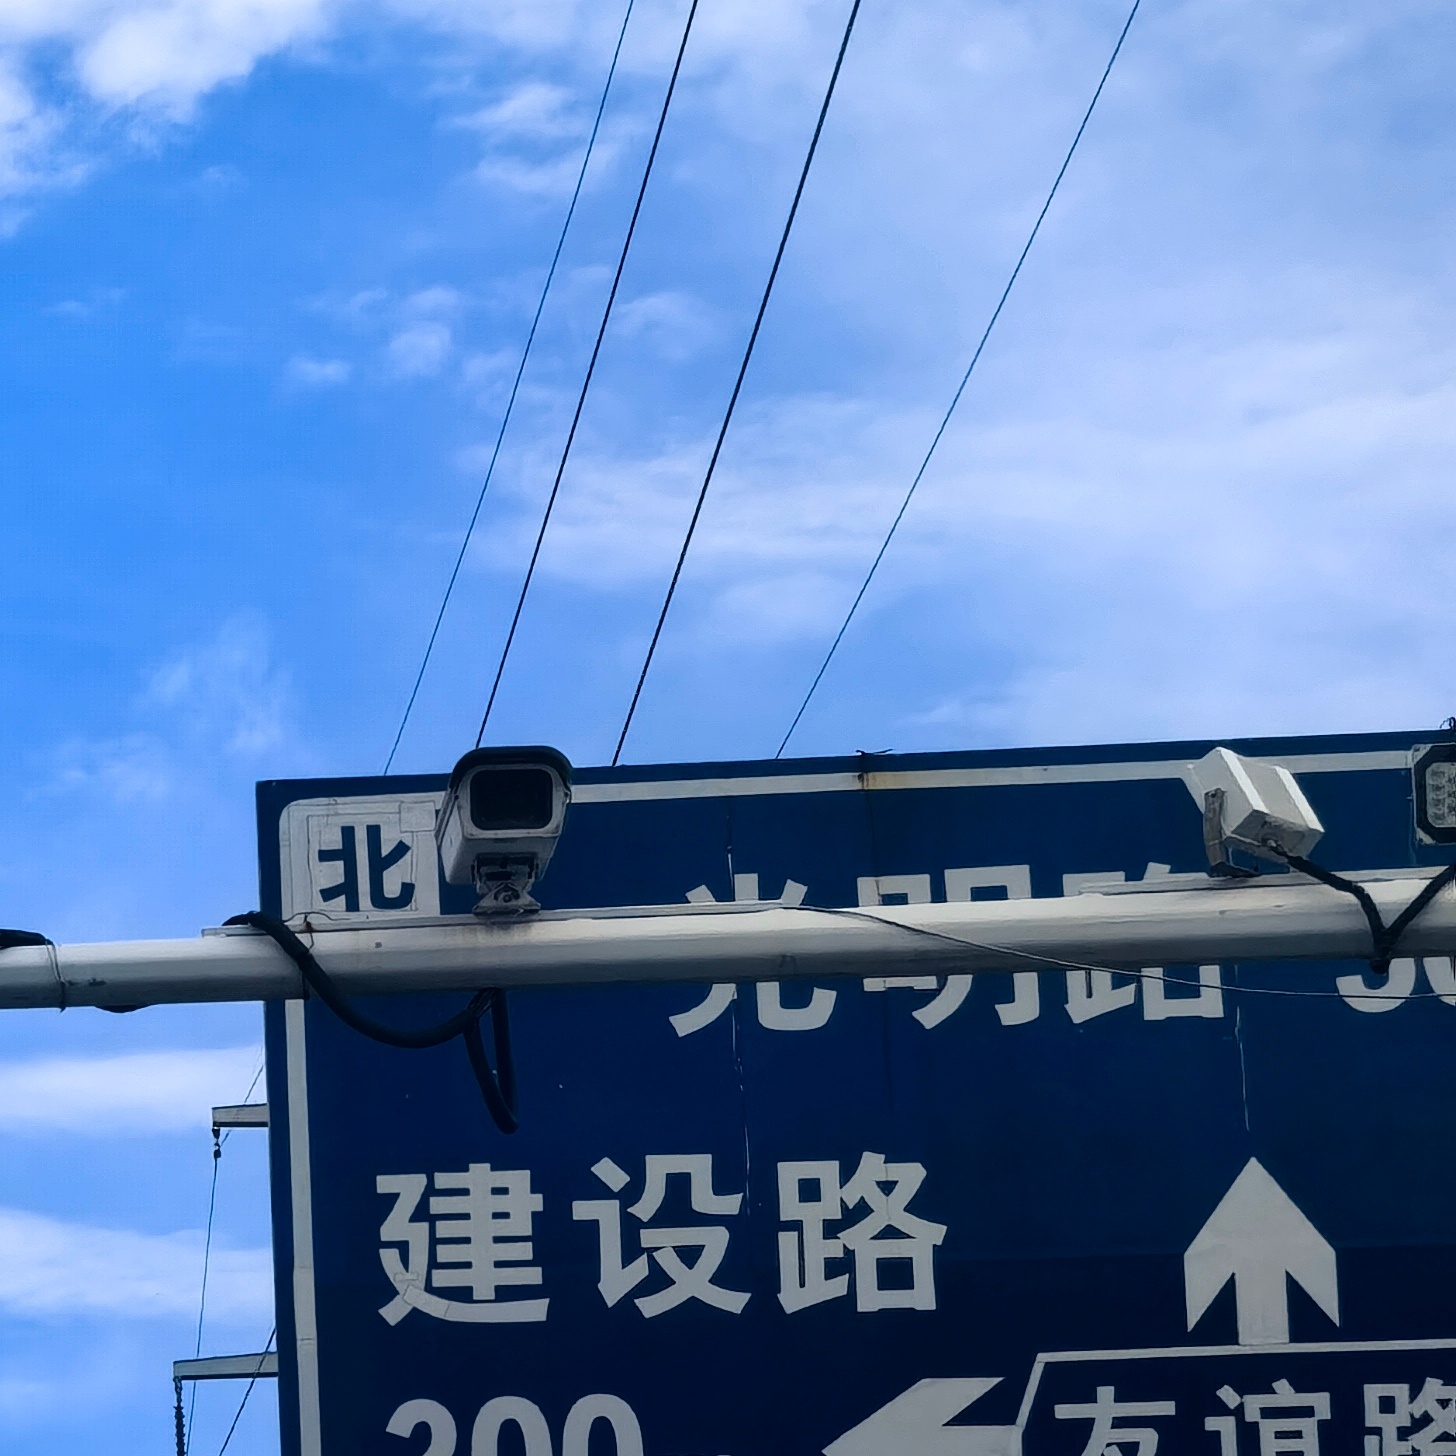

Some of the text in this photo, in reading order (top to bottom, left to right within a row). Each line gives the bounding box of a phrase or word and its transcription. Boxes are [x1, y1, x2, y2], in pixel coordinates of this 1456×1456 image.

[316, 824, 412, 913] 北
[374, 1150, 948, 1326] 建设路
